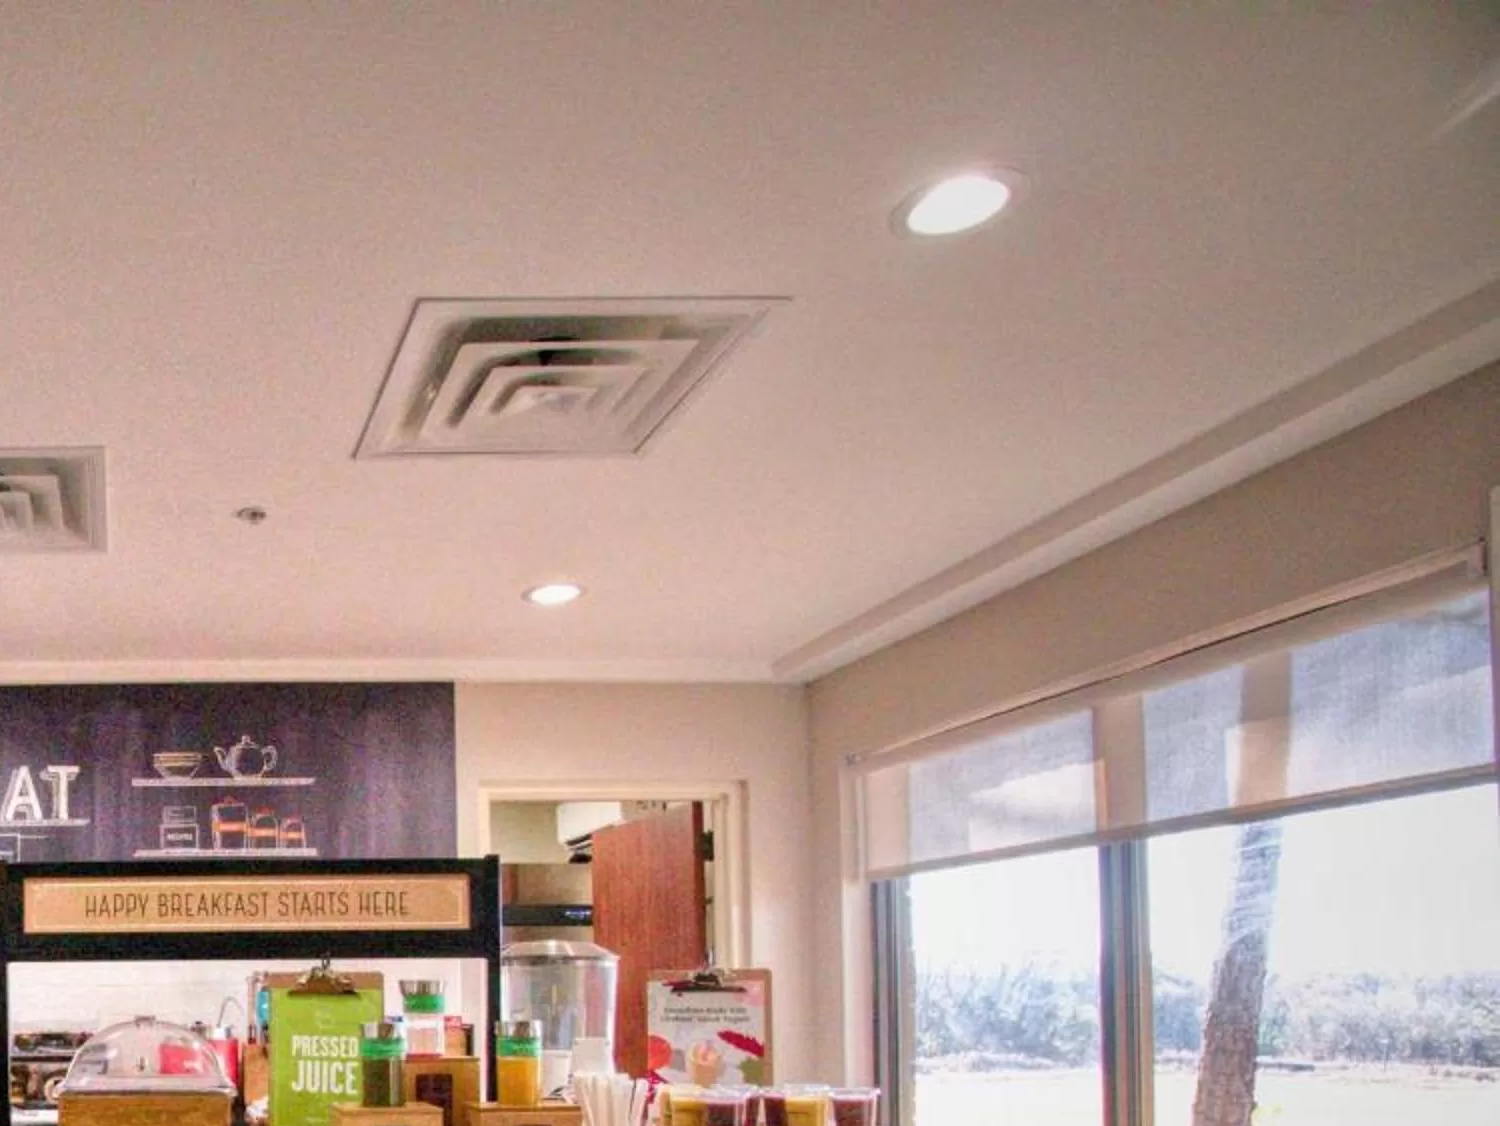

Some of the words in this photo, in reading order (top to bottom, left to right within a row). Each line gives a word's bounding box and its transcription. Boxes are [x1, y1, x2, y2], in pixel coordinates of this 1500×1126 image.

[84, 892, 150, 919] HAPPY
[156, 890, 269, 918] BREAKFAST
[277, 890, 350, 917] STARTS
[358, 889, 412, 916] HERE
[291, 1034, 359, 1058] PRESSED
[291, 1059, 360, 1096] JUICE
